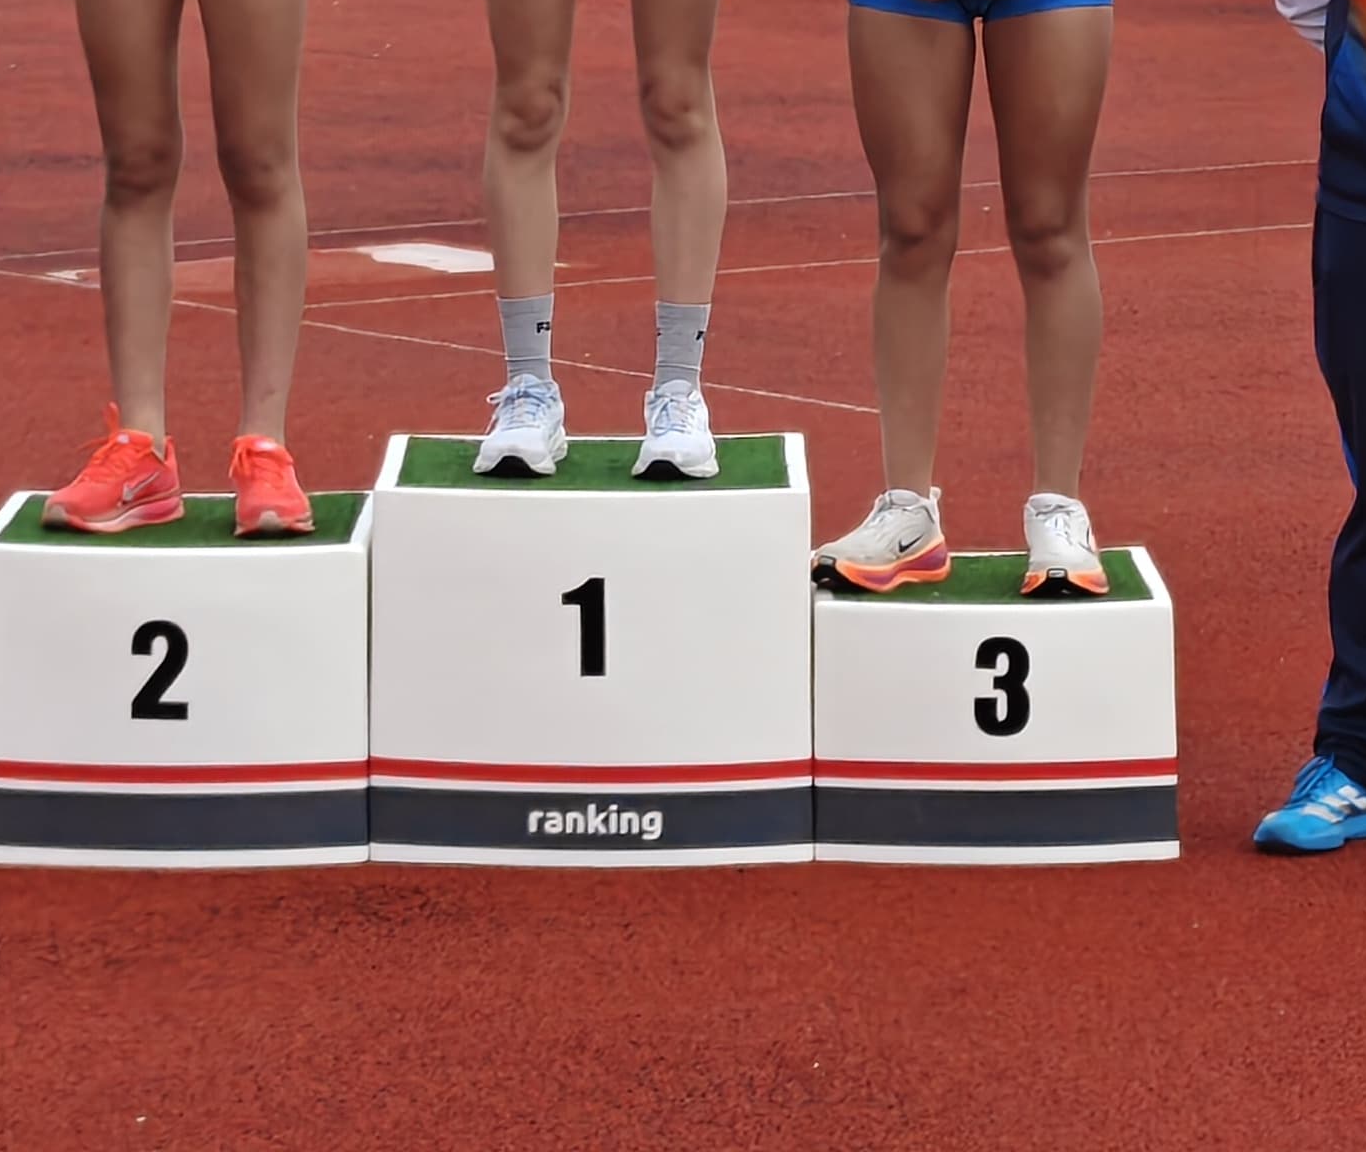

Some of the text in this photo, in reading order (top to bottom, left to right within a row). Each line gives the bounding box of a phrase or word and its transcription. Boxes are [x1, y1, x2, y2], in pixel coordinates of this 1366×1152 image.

[130, 620, 189, 721] 2
[561, 577, 606, 677] 1
[974, 636, 1031, 737] 3
[528, 803, 663, 841] ranking
